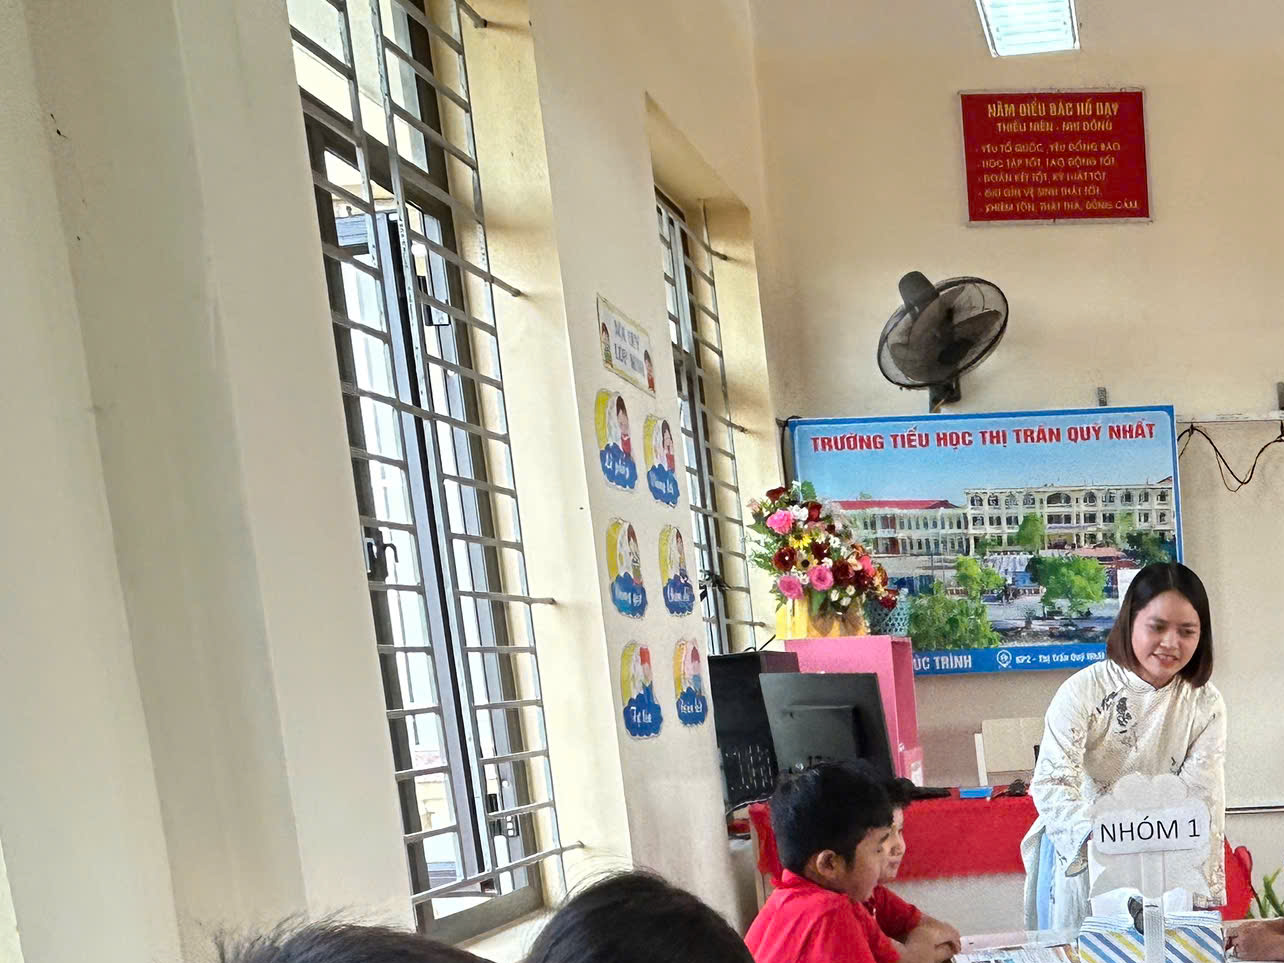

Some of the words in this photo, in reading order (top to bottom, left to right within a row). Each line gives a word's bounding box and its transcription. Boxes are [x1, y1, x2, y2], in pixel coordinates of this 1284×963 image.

[811, 433, 885, 453] TRƯỜNG
[936, 430, 973, 451] HỌC
[979, 429, 1007, 448] THỊ
[934, 654, 972, 670] TRÌNH
[1101, 816, 1178, 843] NHÓM
[1188, 818, 1200, 838] 1
